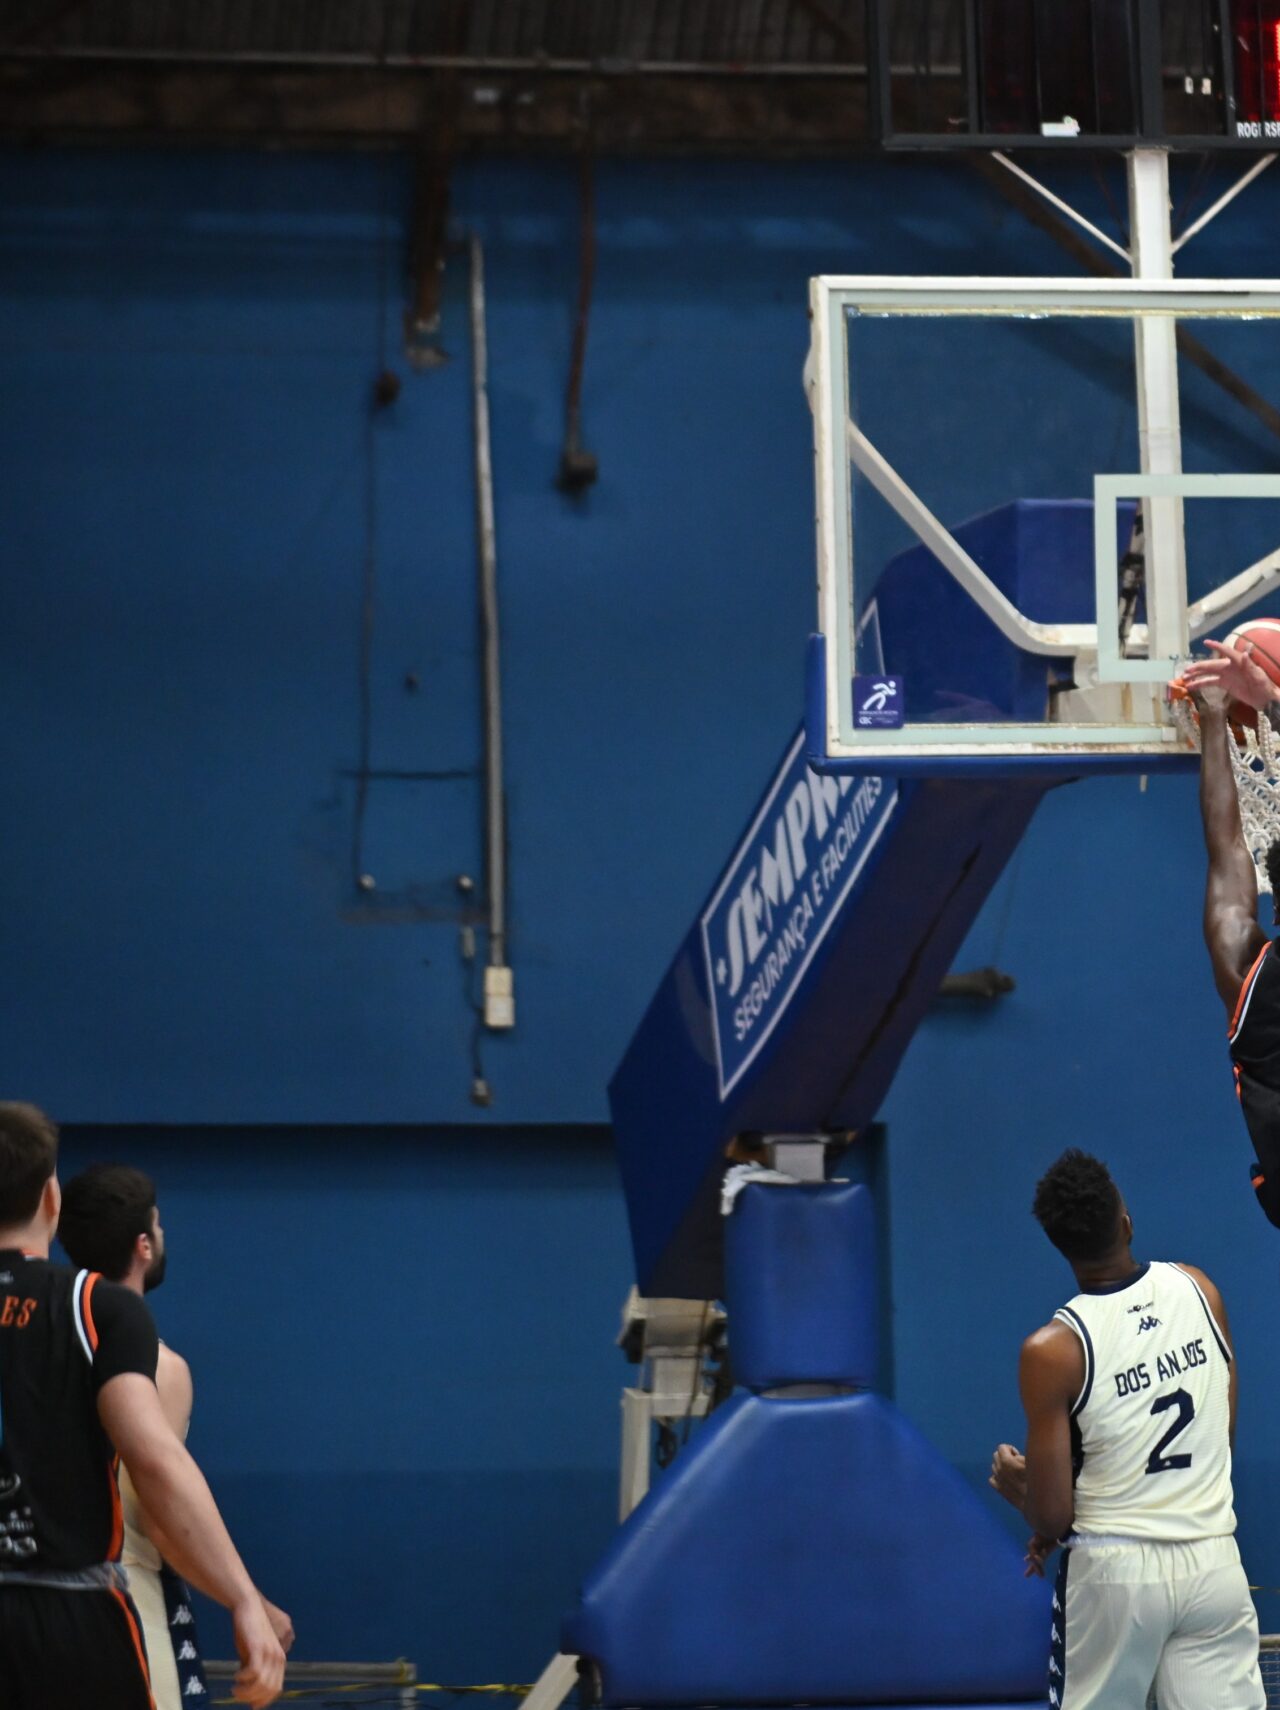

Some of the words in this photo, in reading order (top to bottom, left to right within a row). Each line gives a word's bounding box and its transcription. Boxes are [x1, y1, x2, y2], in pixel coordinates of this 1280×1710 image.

[733, 900, 815, 1042] SEGURANÇA
[812, 871, 824, 906] E
[821, 775, 883, 892] FACILITIES
[1114, 1363, 1151, 1397] DOS
[1156, 1338, 1208, 1382] ANJOS
[1145, 1387, 1195, 1475] 2
